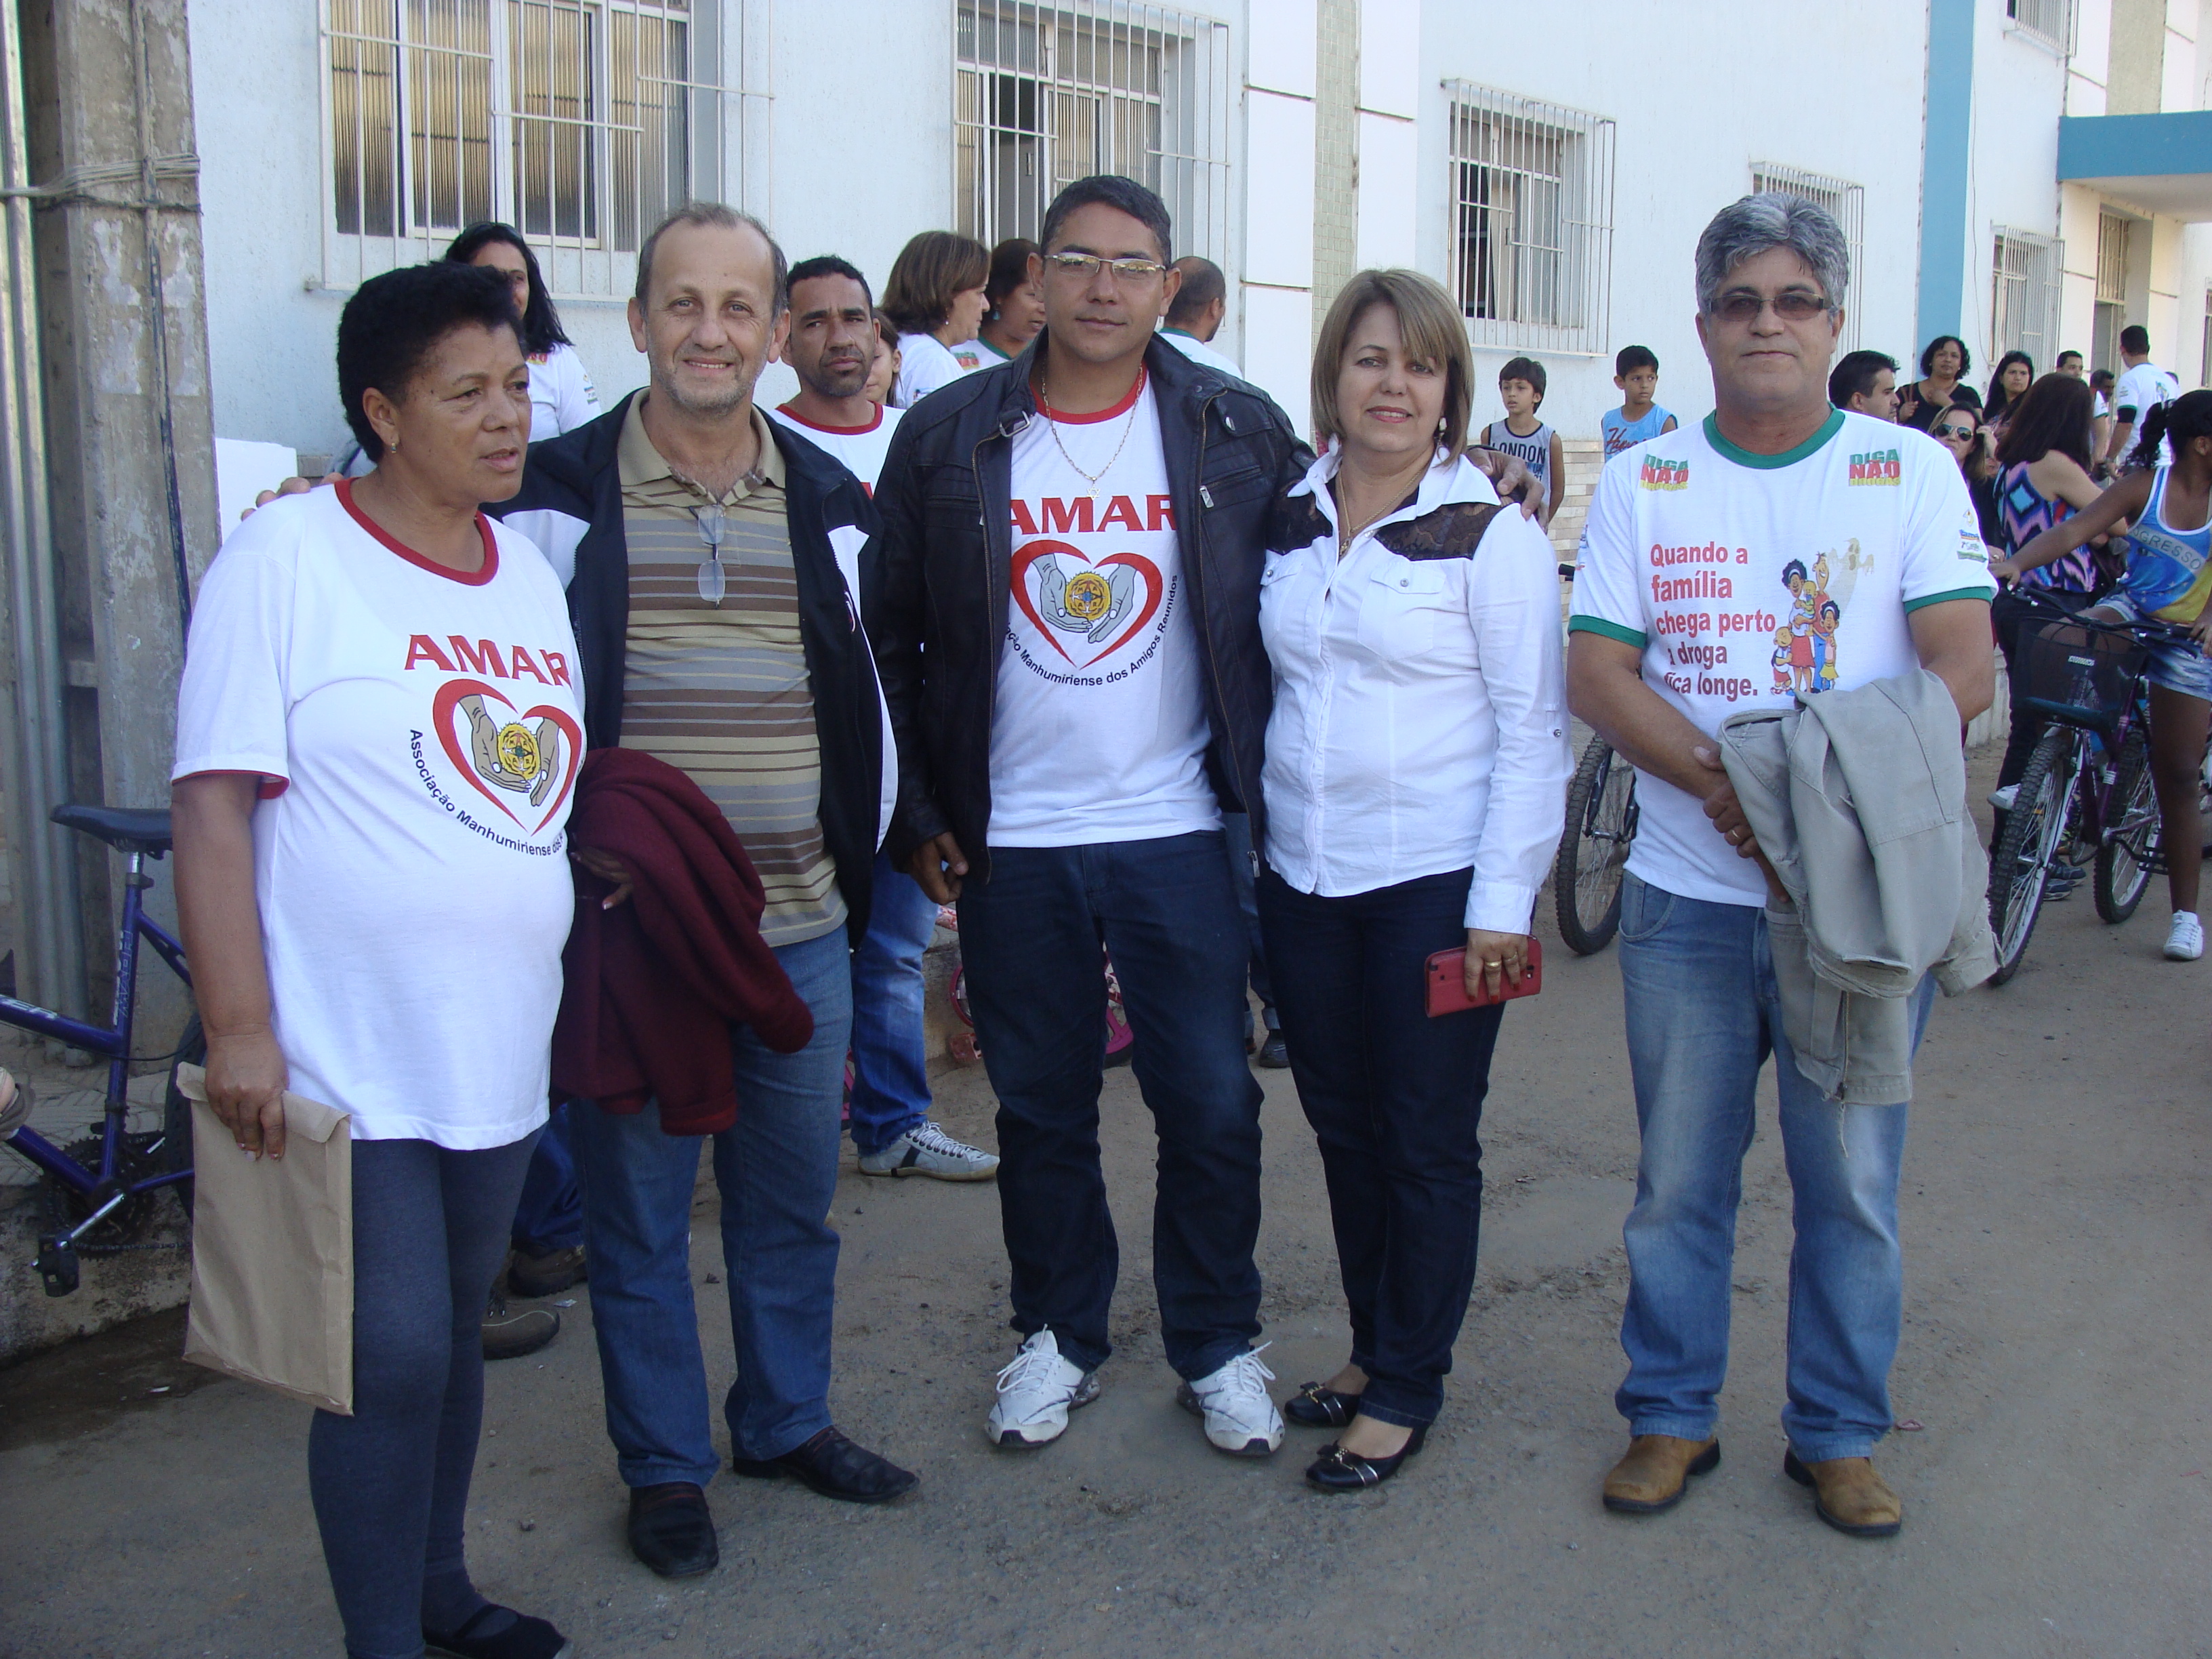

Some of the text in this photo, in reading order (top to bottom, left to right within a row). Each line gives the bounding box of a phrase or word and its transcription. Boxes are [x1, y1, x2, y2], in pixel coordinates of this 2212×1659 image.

[1643, 453, 1689, 471] DIGA
[1849, 449, 1899, 465] DIGA
[1849, 459, 1900, 478] NÃO
[1640, 464, 1689, 484] NÃO
[1010, 494, 1177, 535] AMAR
[1650, 541, 1748, 568] Quando a
[1651, 570, 1732, 602] família
[1020, 649, 1103, 687] Manhumiriense
[1106, 669, 1128, 684] dos
[1130, 634, 1161, 674] Amigos
[1157, 575, 1178, 634] Reunidos
[1656, 609, 1776, 638] chega perto
[404, 634, 573, 691] AMAR
[1677, 641, 1727, 670] droga
[1697, 672, 1758, 702] longe.
[409, 729, 455, 813] Associação
[456, 810, 552, 857] Manhumiriense
